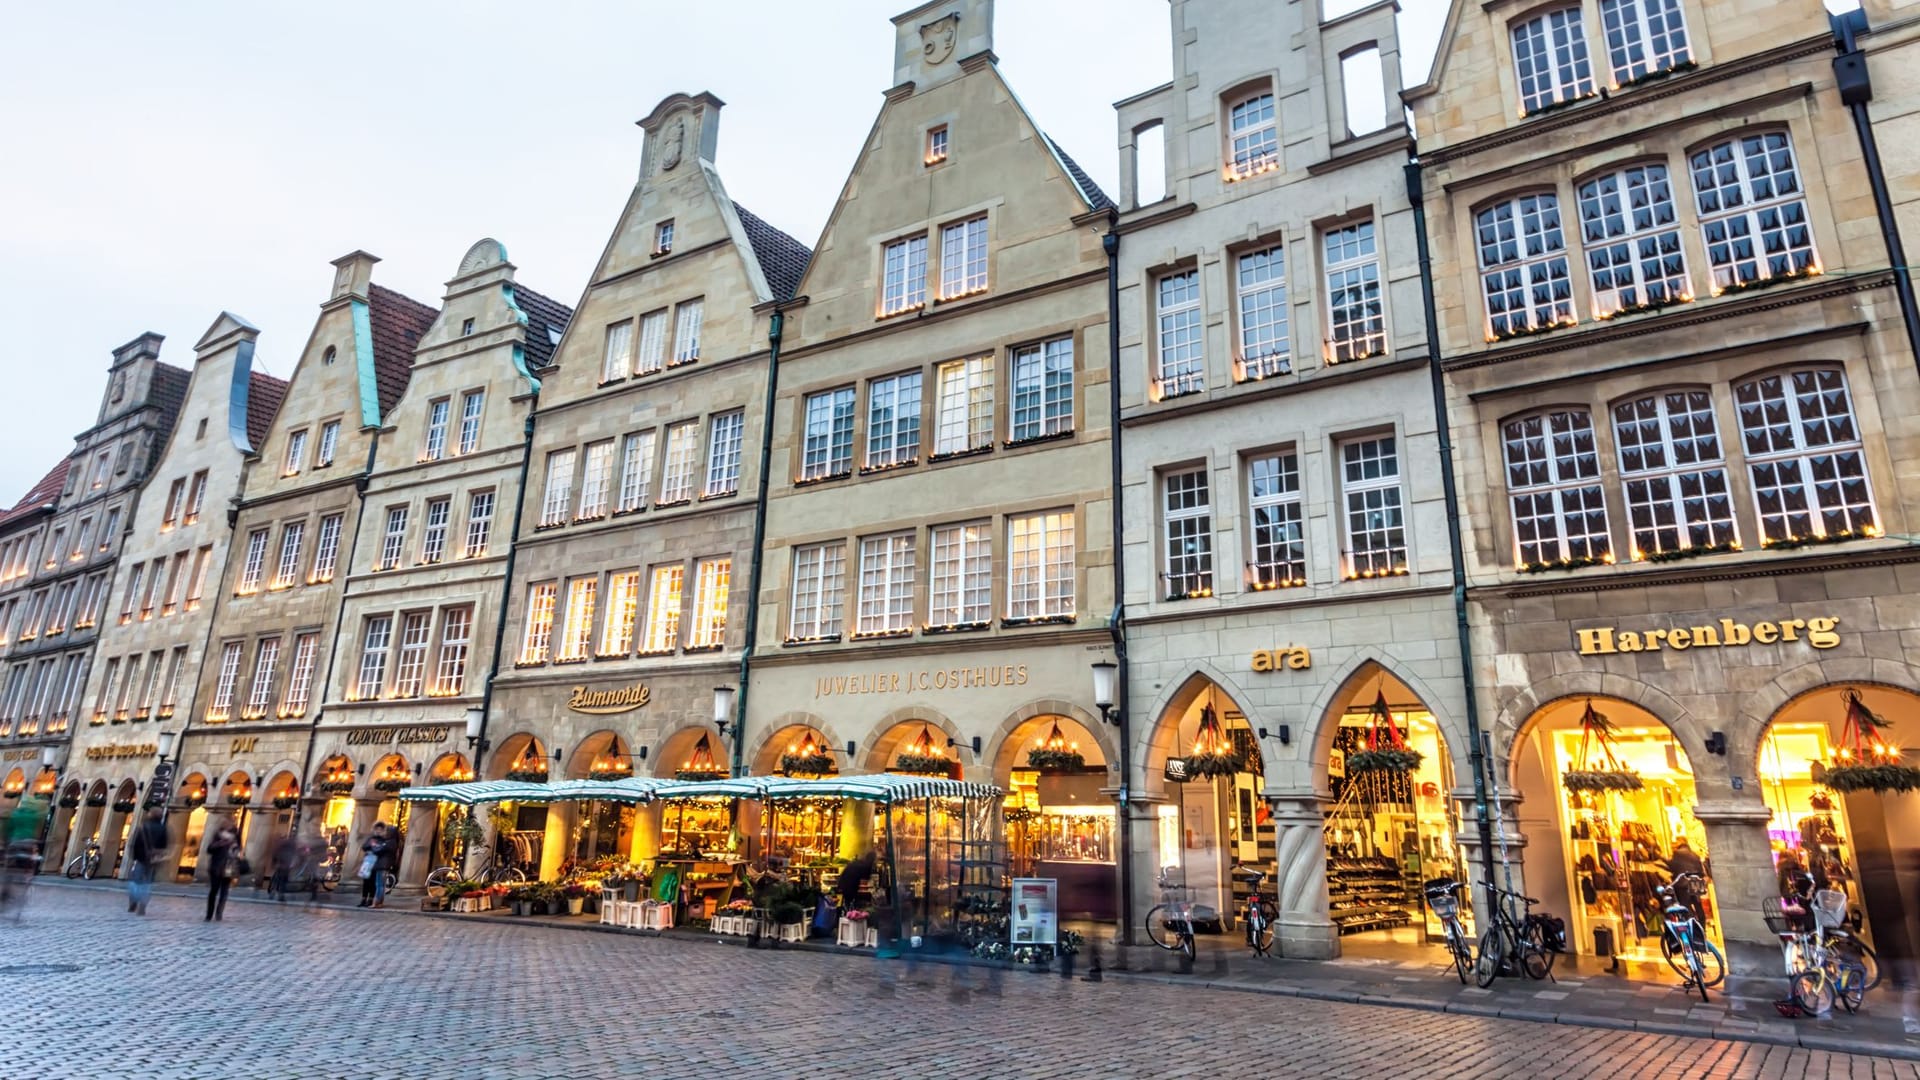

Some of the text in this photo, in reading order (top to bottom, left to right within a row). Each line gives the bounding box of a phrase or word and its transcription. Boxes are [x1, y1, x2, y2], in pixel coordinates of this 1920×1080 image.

[1576, 616, 1842, 656] Harenberg
[1251, 647, 1311, 672] ara
[567, 682, 651, 711] Zumnorde
[815, 671, 900, 698] JUWELIER
[230, 736, 260, 760] pur
[346, 726, 450, 745] COUNTRY CLASSICS
